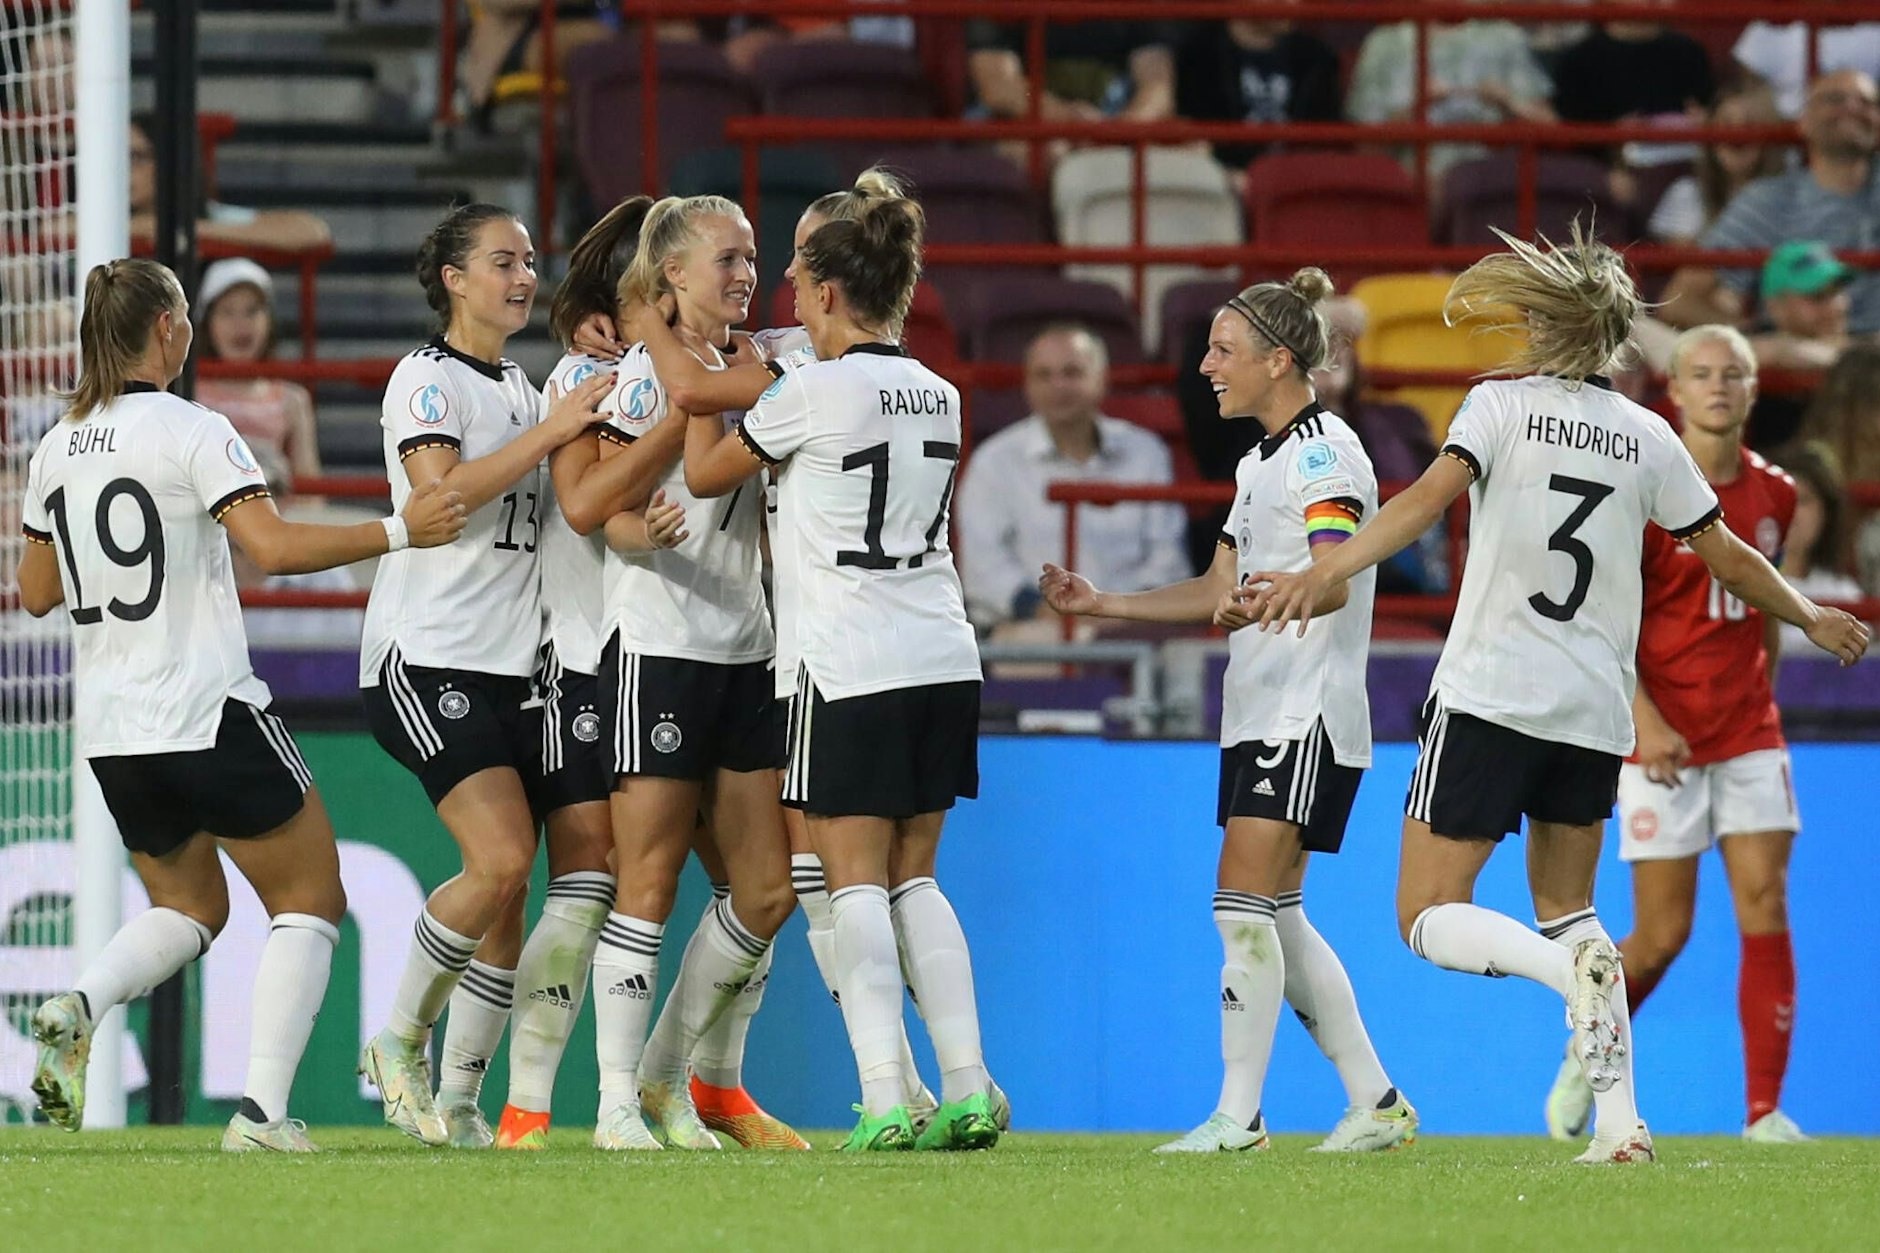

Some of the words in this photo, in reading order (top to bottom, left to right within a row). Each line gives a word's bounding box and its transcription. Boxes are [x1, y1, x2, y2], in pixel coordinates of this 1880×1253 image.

[880, 389, 948, 416] RAUCH
[68, 424, 117, 457] BÜHL
[1527, 413, 1639, 464] HENDRICH
[493, 492, 537, 553] 13
[836, 440, 960, 570] 17
[45, 477, 165, 625] 19
[1527, 473, 1615, 622] 3
[528, 988, 575, 1010] adidas
[608, 982, 652, 1001] adidas
